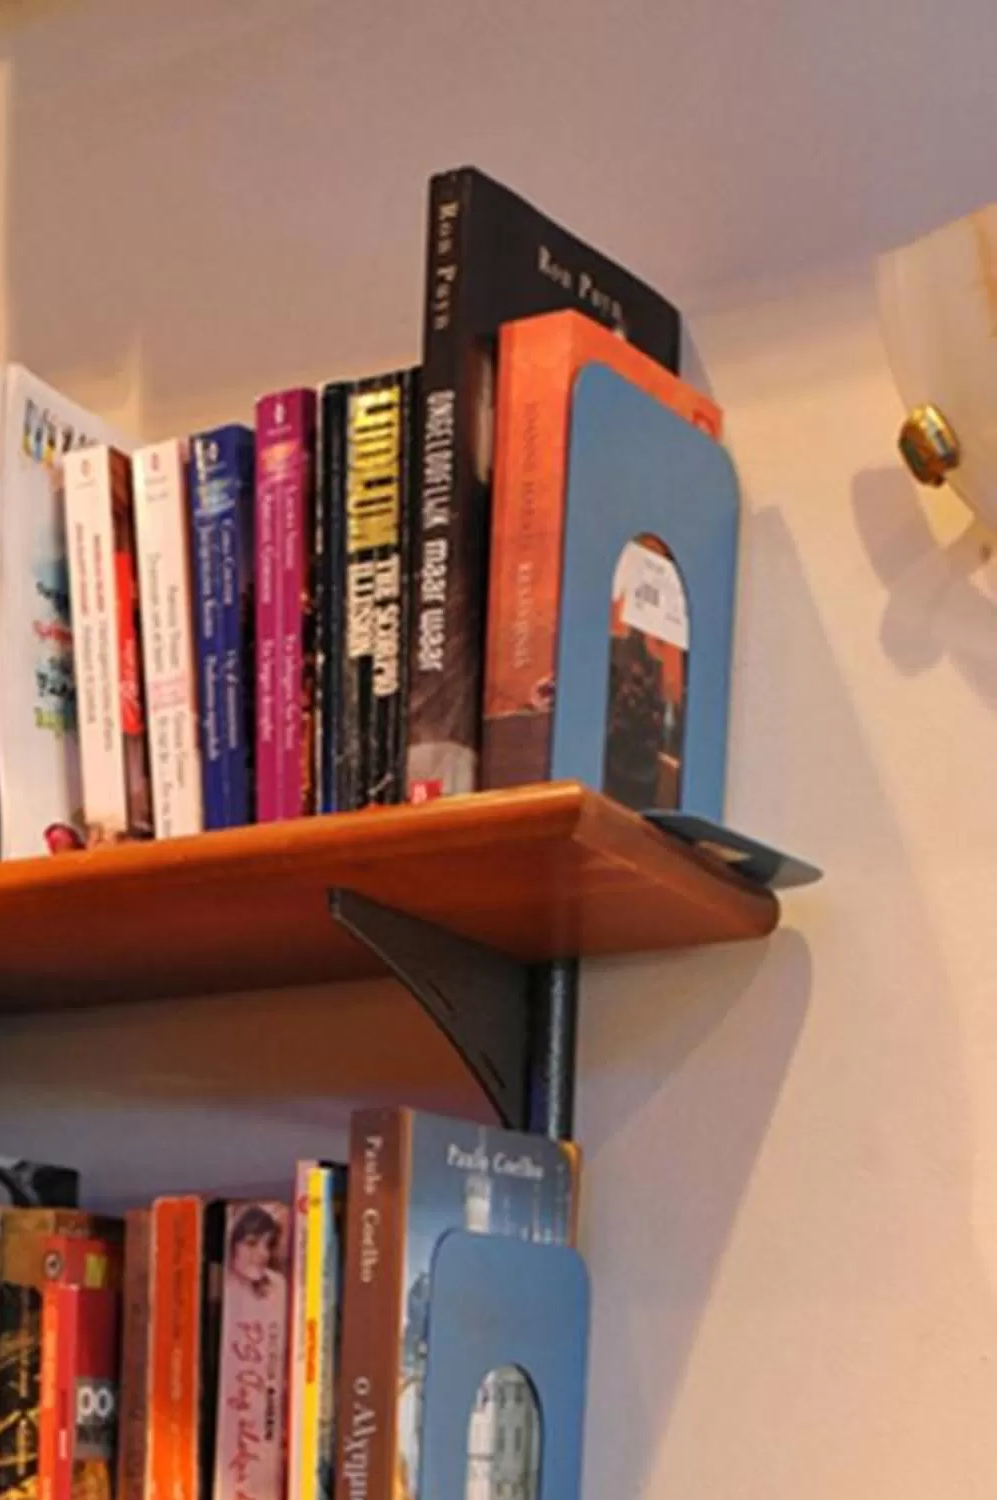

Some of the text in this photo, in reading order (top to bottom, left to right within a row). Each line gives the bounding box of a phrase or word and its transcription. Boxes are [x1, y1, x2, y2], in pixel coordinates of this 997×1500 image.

[346, 385, 401, 553] LUDLUM
[420, 536, 450, 605] maar
[417, 606, 445, 673] waar
[493, 1150, 544, 1181] Coelho
[359, 1136, 384, 1283] Paulo Coelho
